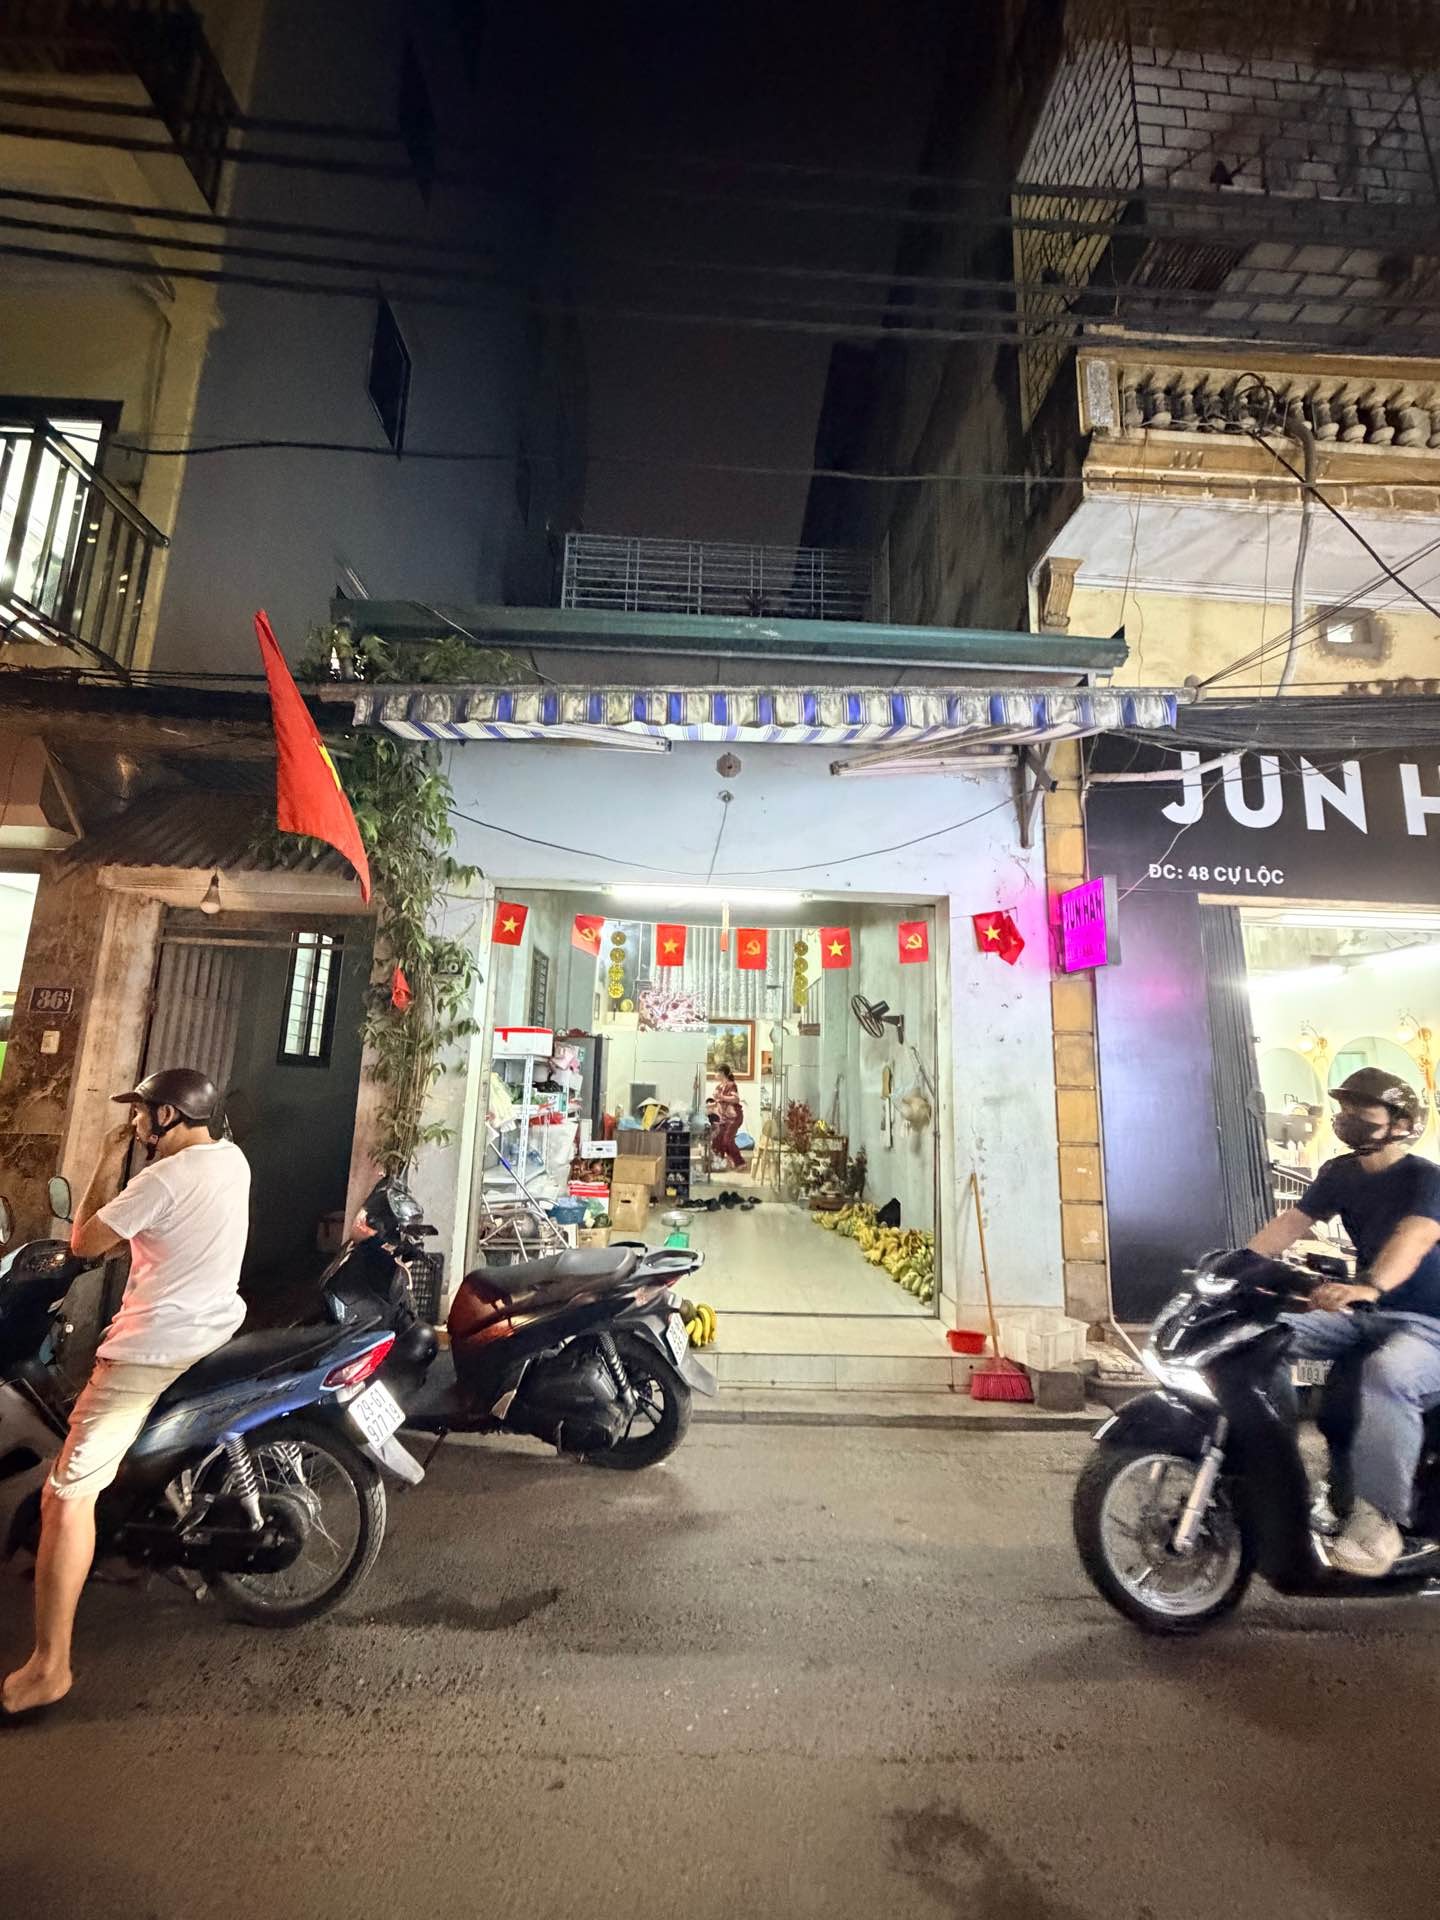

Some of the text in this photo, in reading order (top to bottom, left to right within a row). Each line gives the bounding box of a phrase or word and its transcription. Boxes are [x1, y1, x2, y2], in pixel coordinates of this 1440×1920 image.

[1161, 751, 1367, 834] JUN
[1149, 864, 1284, 887] ĐC: 48 CỰ LỘC
